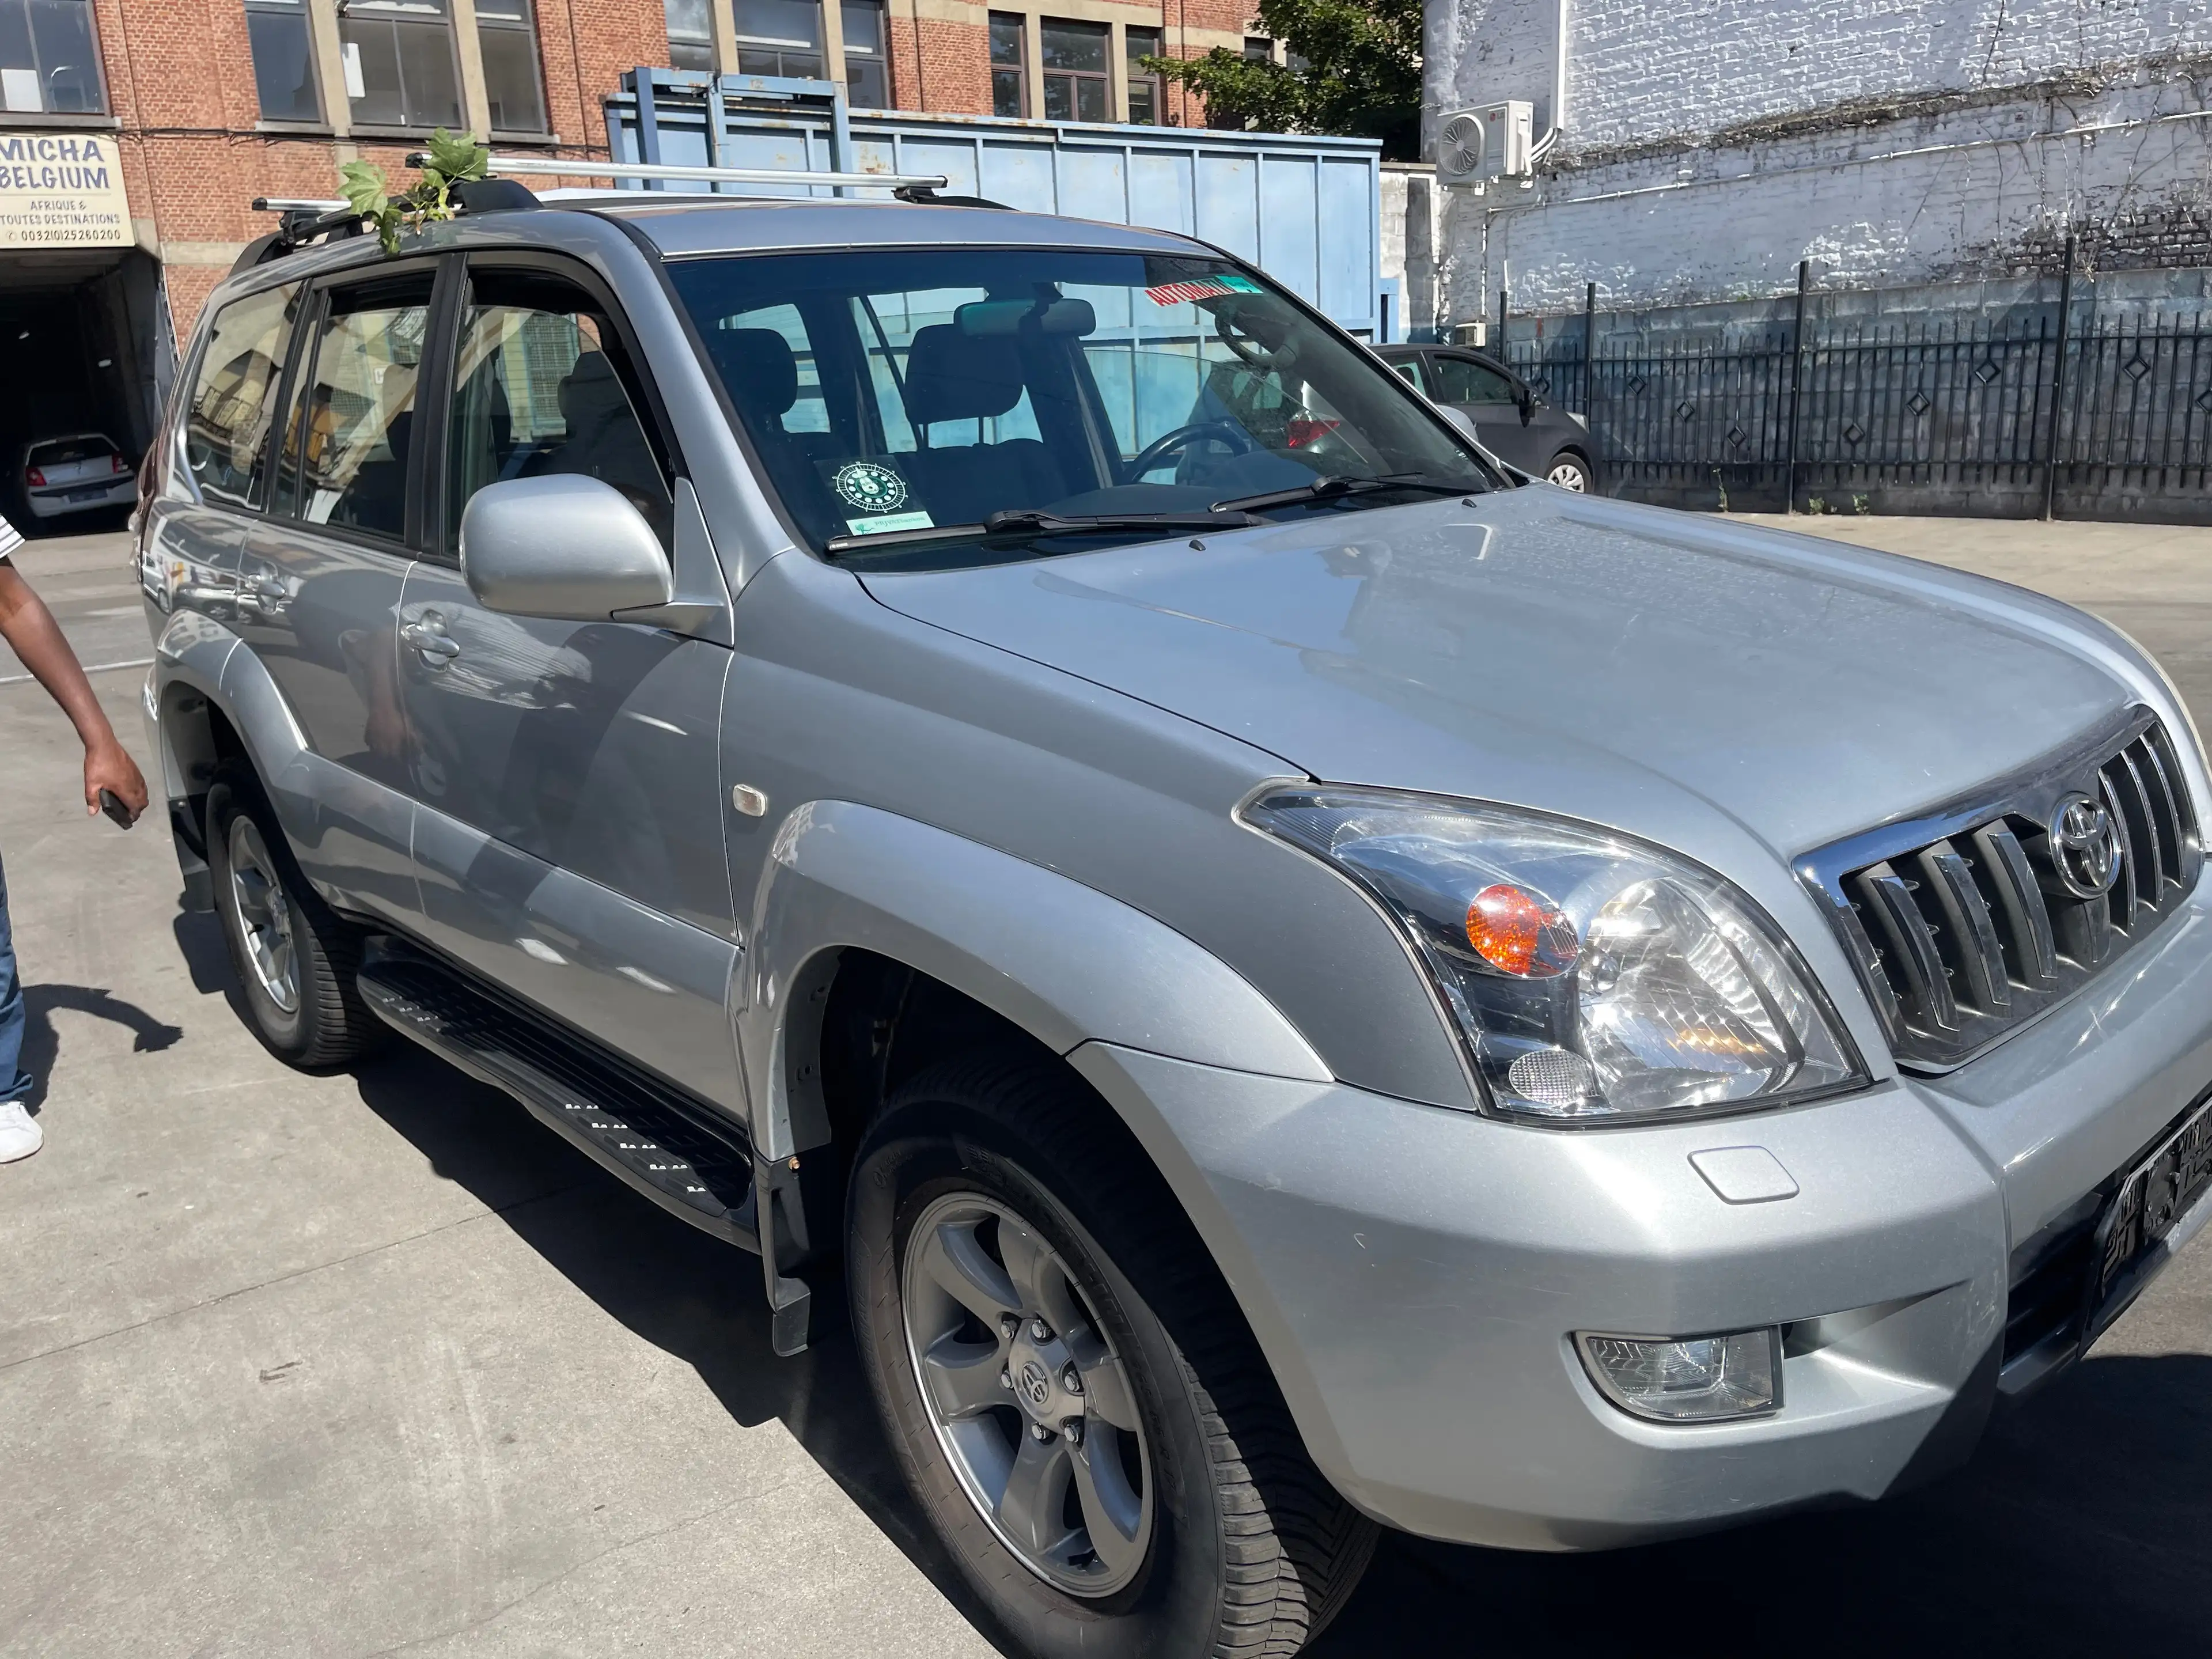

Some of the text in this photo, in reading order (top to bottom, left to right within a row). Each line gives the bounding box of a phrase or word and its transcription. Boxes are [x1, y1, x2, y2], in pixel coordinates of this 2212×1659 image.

[0, 139, 105, 162] MICHA
[0, 166, 109, 189] BELGIUM
[31, 200, 76, 210] AFRIQUE
[1, 213, 120, 225] TOUTES DESTINATIONS
